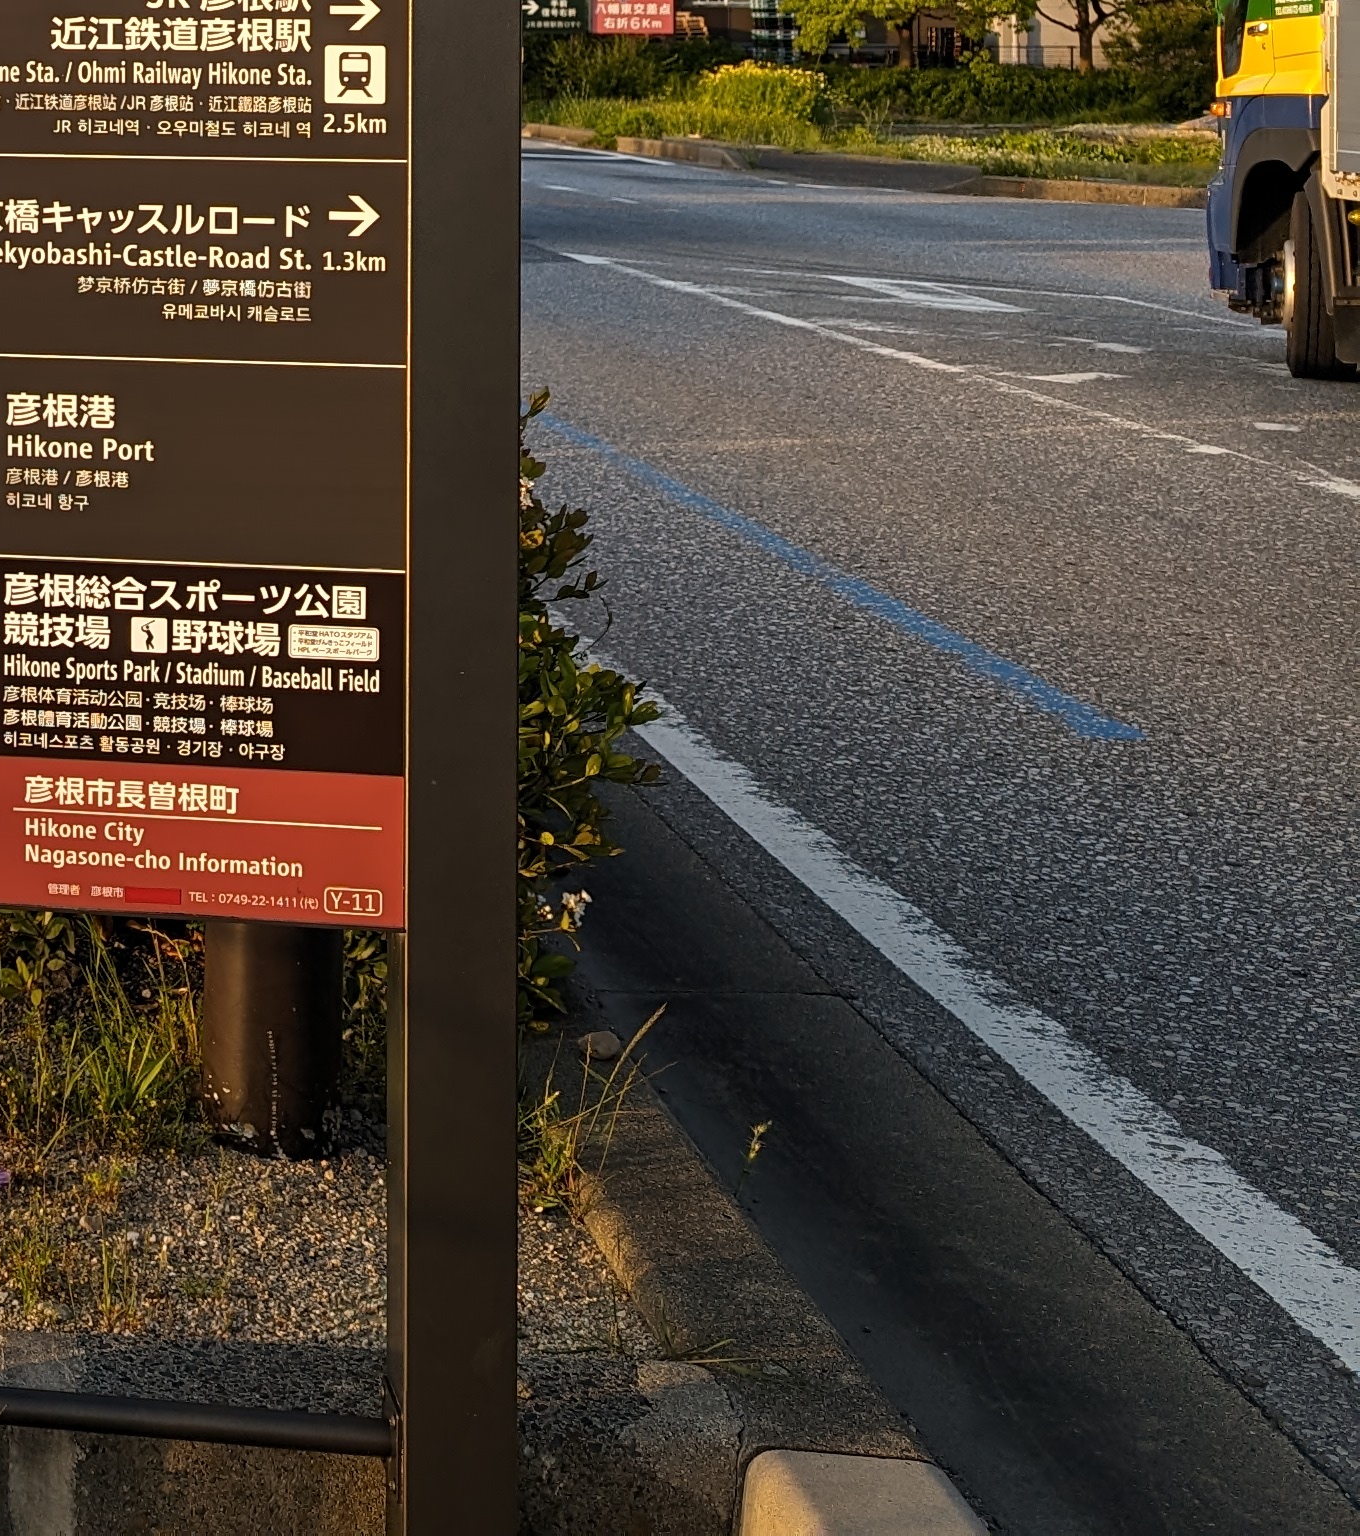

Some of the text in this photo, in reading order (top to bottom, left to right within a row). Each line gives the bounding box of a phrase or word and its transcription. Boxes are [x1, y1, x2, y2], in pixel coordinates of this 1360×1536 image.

[50, 16, 312, 53] 近江鉄道彦根駅
[25, 60, 60, 83] Sta.
[77, 60, 126, 84] Ohmi
[133, 60, 203, 90] Railway
[208, 61, 272, 86] Hikone
[277, 63, 312, 86] Sta.
[52, 118, 311, 139] JR 히코네역 오우미철도 히코네 역
[323, 112, 387, 134] 2.5km
[279, 247, 312, 271] St.
[322, 250, 386, 272] 1.3km
[161, 303, 312, 323] 유메쿄바시 캐슬로드
[5, 391, 116, 429] 彦根港
[7, 433, 155, 462] Hikone Port
[5, 466, 59, 486] 彦根港
[5, 491, 90, 512] 히코네 항구
[3, 571, 368, 620] 彦根総合スポーツ公園
[3, 610, 281, 657] 競技場 野球場
[3, 653, 61, 679] Hikone
[65, 656, 118, 685] Sports
[123, 659, 161, 683] Park
[175, 661, 245, 687] Stadium
[261, 665, 334, 691] Baseball
[338, 668, 380, 693] Field
[3, 730, 286, 761] 히코네스포츠 활동공원 경기장 야구장
[23, 774, 240, 815] 彦根市長曽根町
[25, 817, 145, 846] Hikone City
[25, 841, 303, 878] Nagasone-cho Information
[47, 882, 81, 896] 管理者
[329, 889, 377, 913] Y-11
